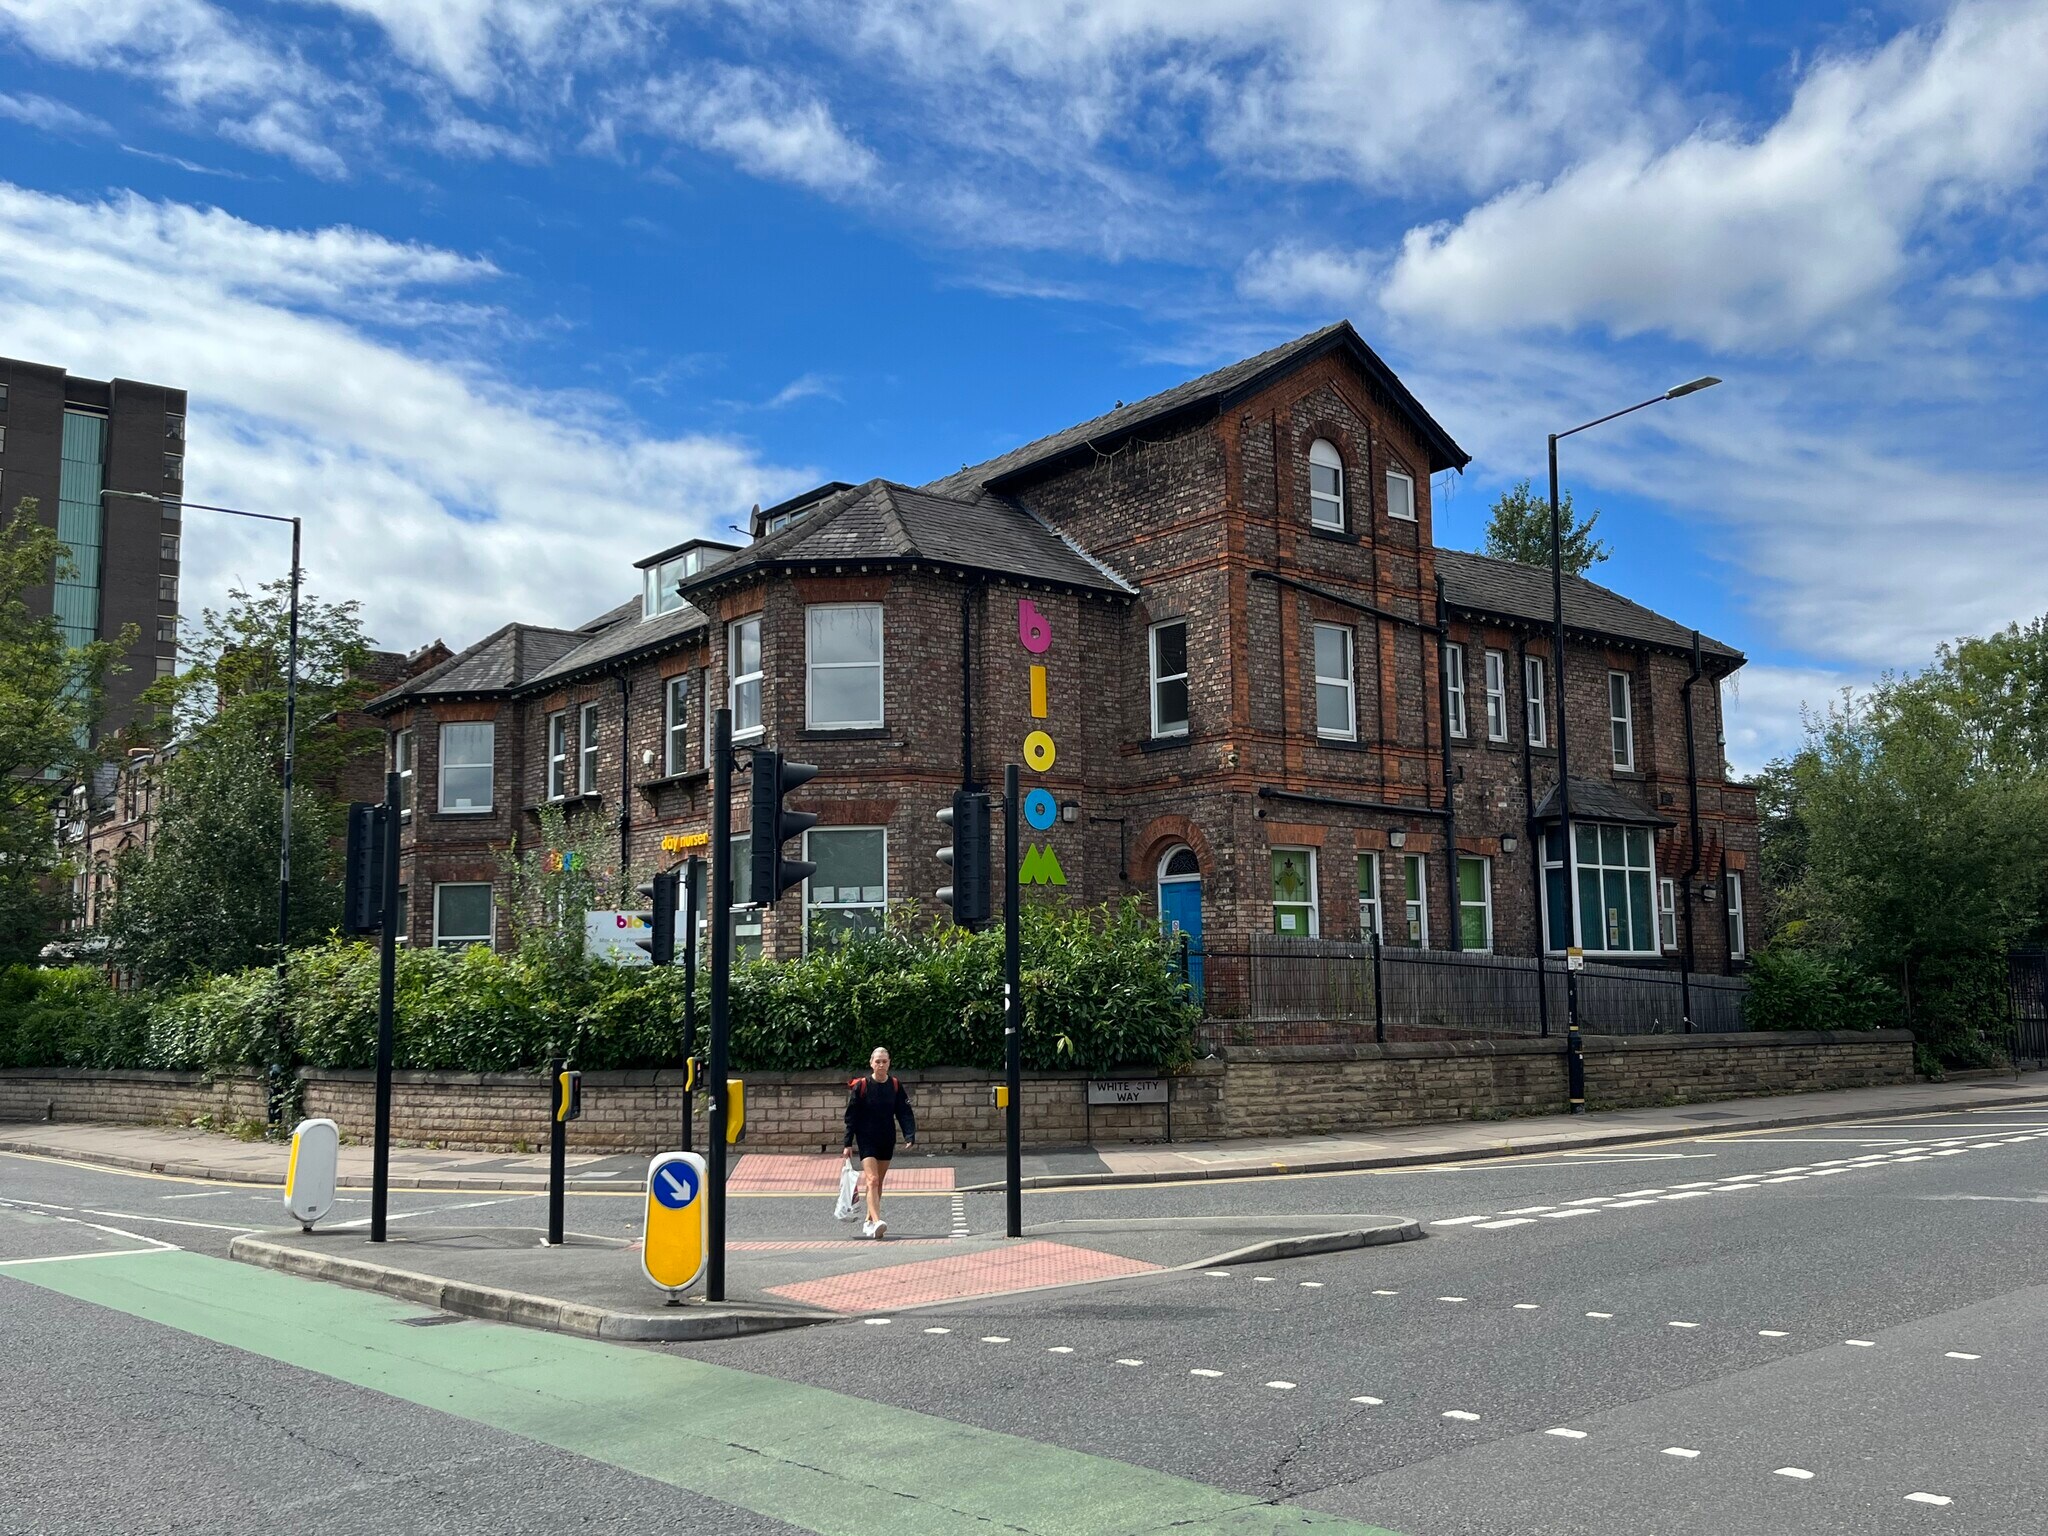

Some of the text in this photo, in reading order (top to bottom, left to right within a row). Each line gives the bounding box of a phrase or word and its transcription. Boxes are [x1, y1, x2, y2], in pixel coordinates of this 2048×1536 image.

[661, 832, 709, 852] day nurser
[1097, 1081, 1159, 1092] WHITE CITY
[1117, 1092, 1140, 1102] WAY
